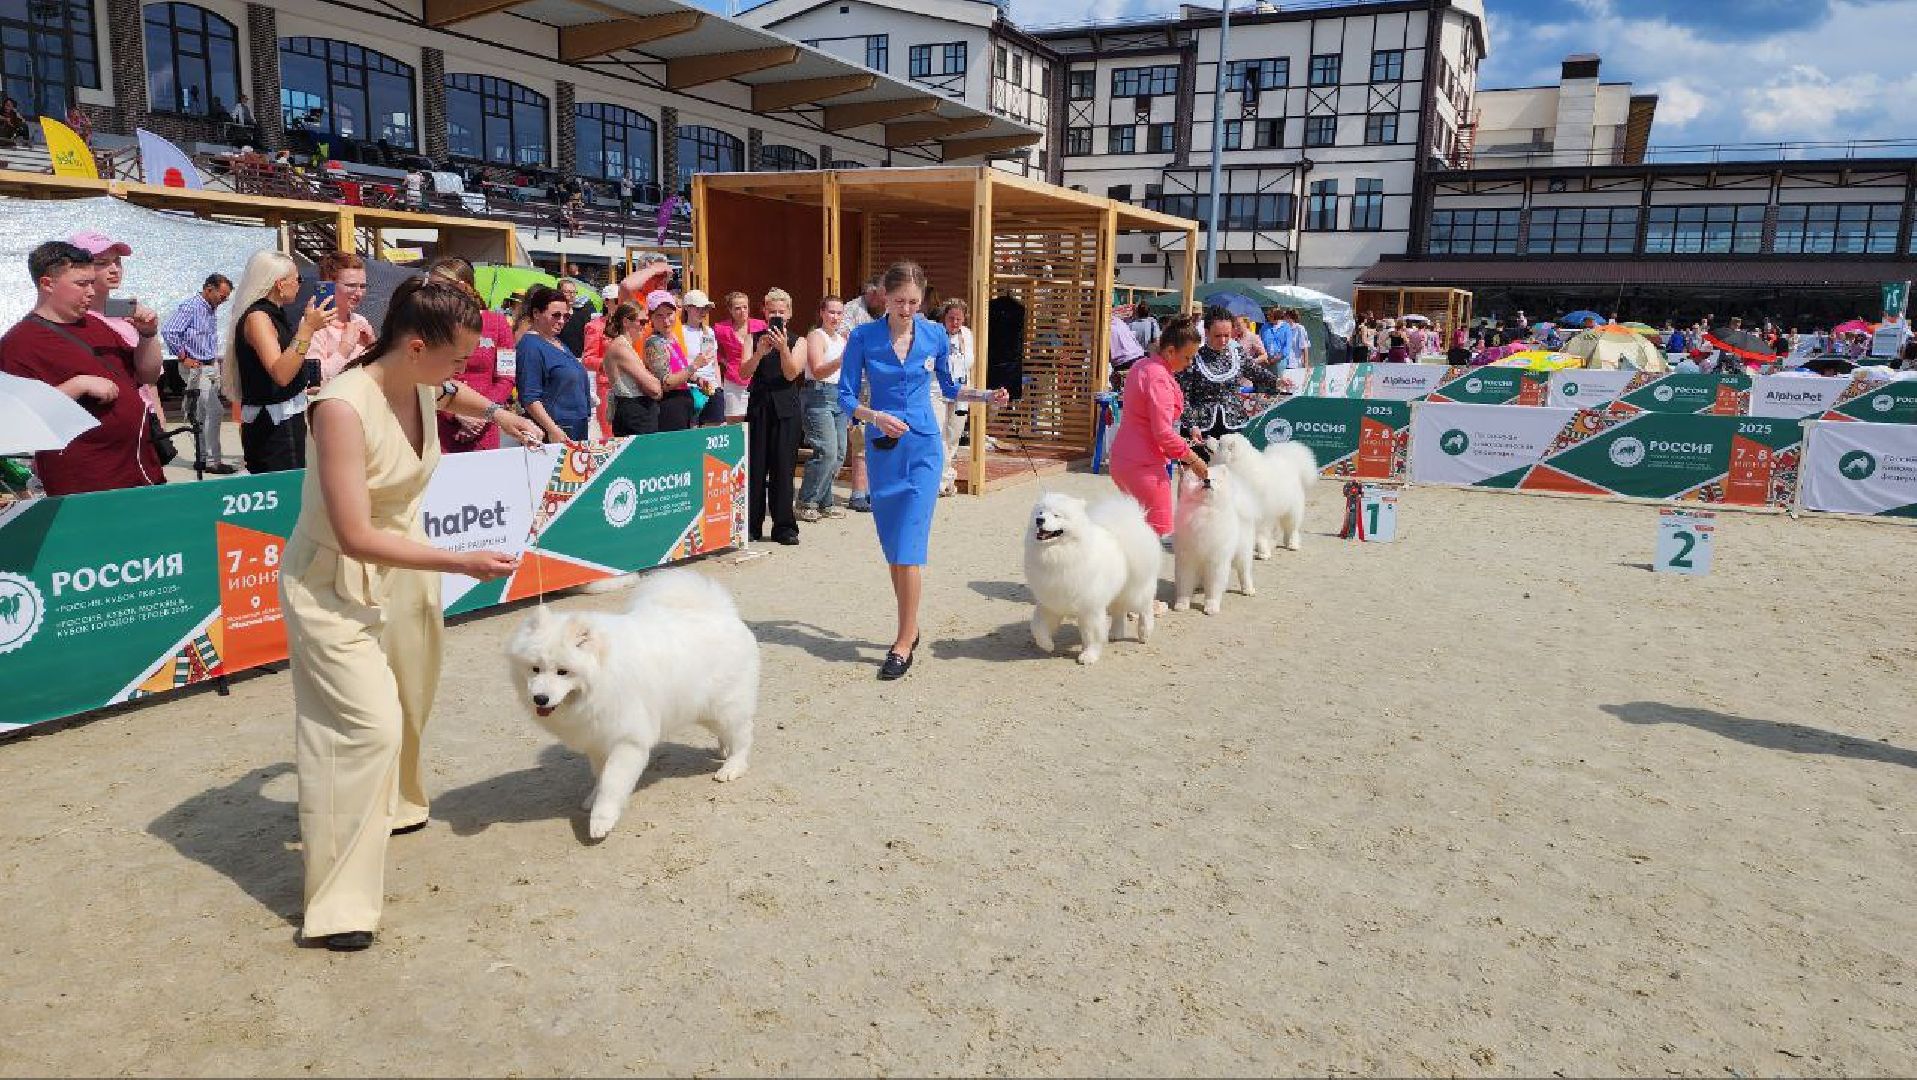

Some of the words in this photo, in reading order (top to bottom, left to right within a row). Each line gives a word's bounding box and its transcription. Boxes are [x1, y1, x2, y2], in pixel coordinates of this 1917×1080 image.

[1766, 391, 1822, 402] AlphaPet
[1365, 406, 1393, 415] 2025
[1295, 421, 1347, 433] РОССИЯ
[1738, 422, 1772, 433] 2025
[705, 434, 730, 450] 2025
[1649, 440, 1714, 454] РОССИЯ
[639, 470, 691, 495] РОССИЯ
[222, 490, 279, 516] 2025
[423, 500, 506, 537] haPet
[1367, 504, 1379, 534] 1
[1669, 531, 1695, 567] 2
[51, 552, 183, 596] РОССИЯ
[228, 569, 280, 591] ИЮНЯ
